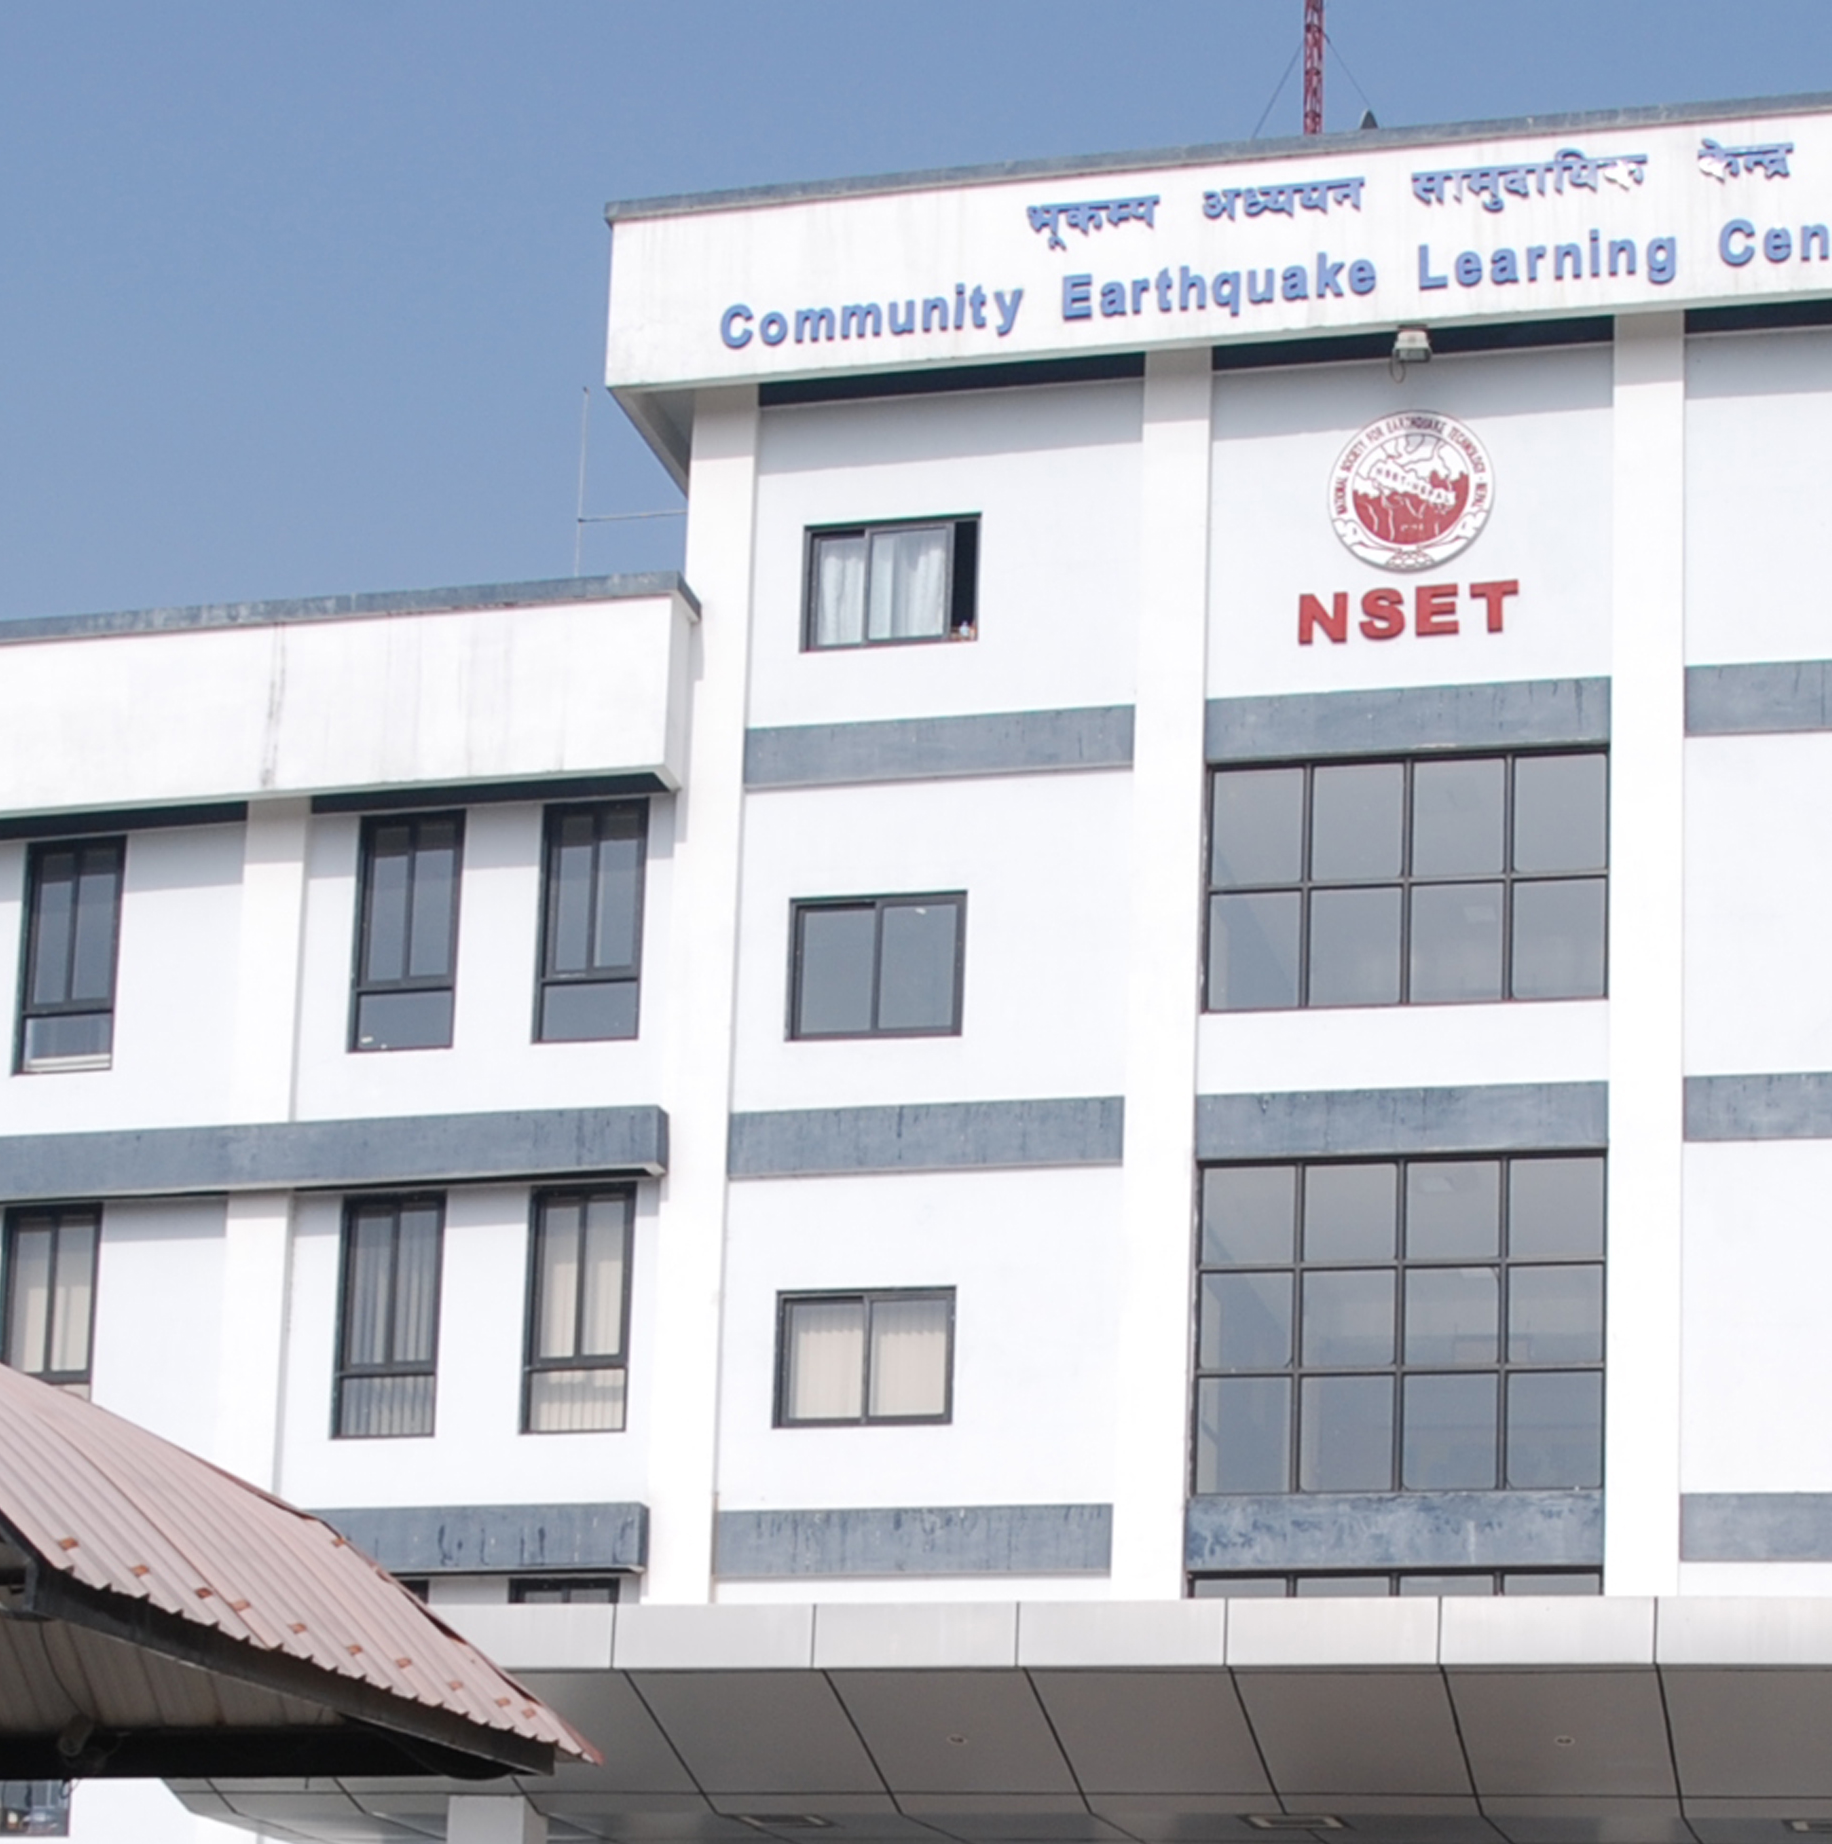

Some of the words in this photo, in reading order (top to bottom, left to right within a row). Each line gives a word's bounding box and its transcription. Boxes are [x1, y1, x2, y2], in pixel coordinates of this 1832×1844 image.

[1026, 191, 1161, 249] भूकम्प
[1203, 174, 1367, 221] अध्ययन
[720, 281, 1024, 350] Community
[1061, 250, 1377, 318] Earthquake
[1418, 227, 1678, 291] Learning
[1365, 427, 1385, 443] FOR
[1297, 579, 1520, 645] NSET
